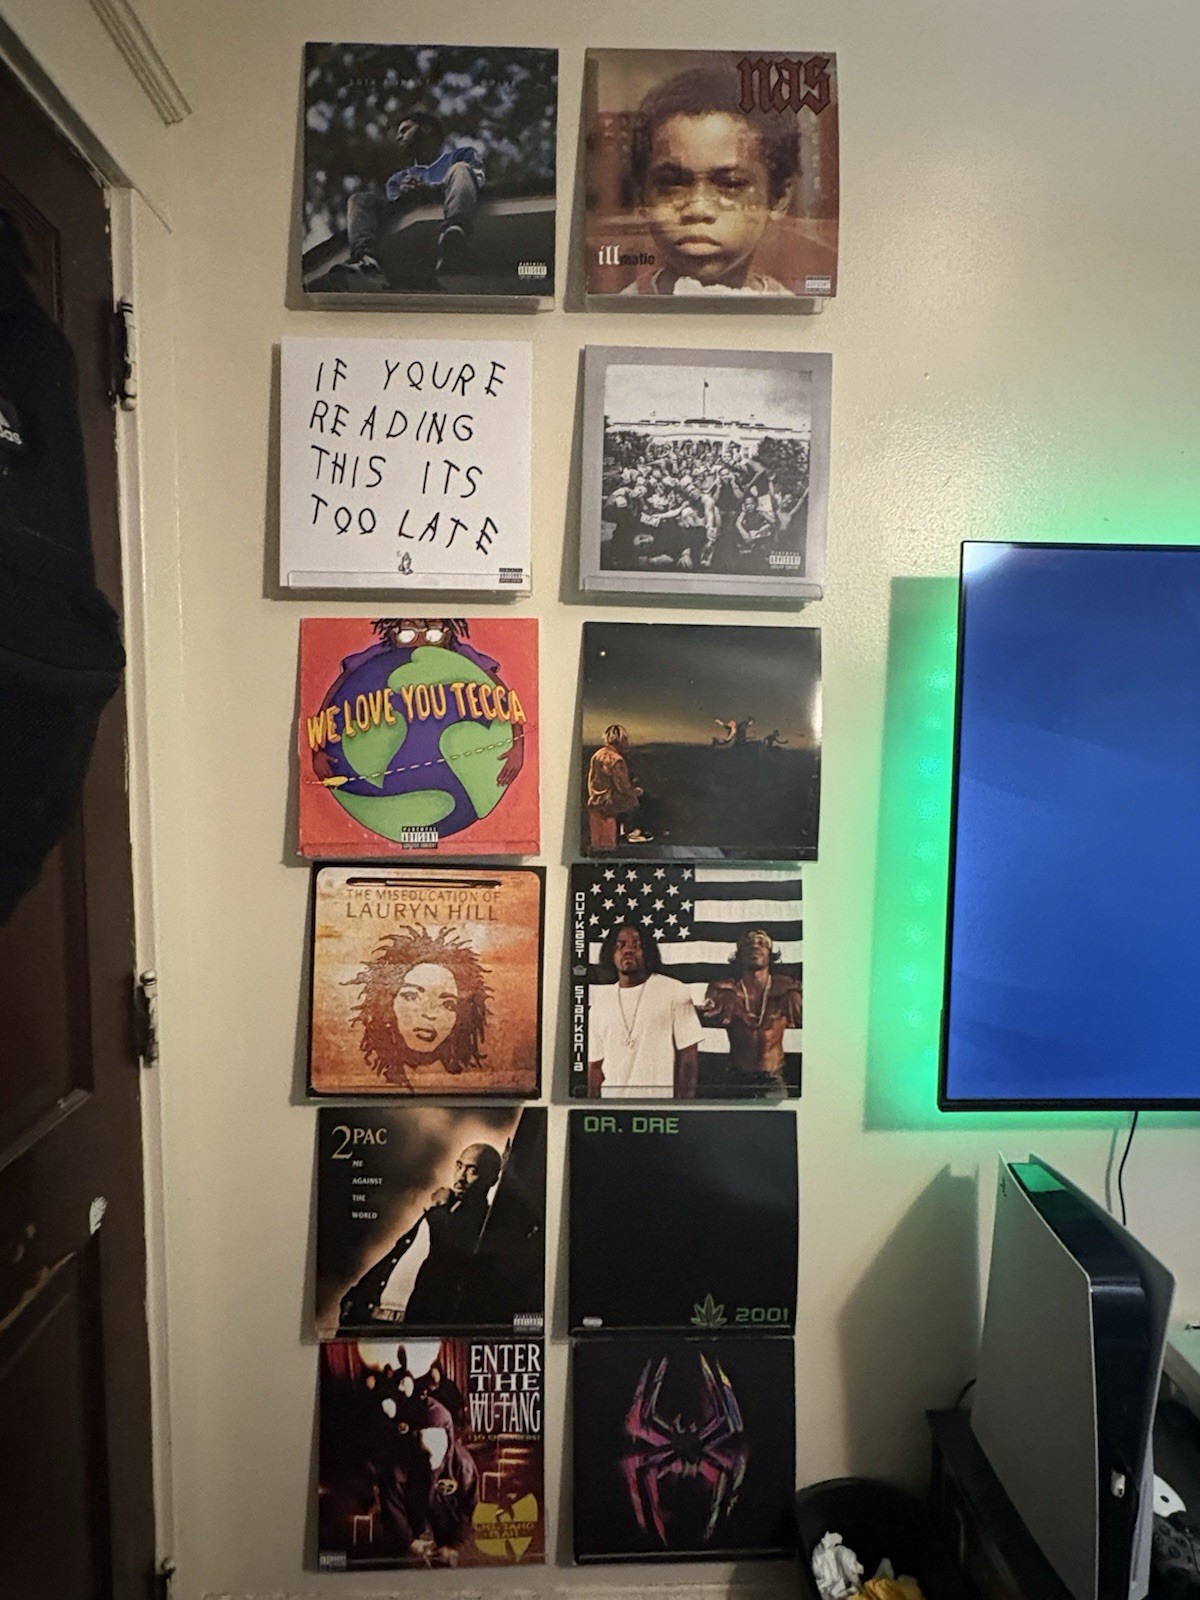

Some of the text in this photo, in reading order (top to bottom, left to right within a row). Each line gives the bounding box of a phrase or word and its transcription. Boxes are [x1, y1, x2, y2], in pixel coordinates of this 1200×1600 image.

[315, 357, 506, 397] IF YOURE
[309, 399, 474, 445] READING
[310, 444, 483, 499] THIS ITS
[311, 493, 499, 556] TOO LATE
[307, 682, 527, 751] WE LOVE YOU TECCA
[346, 888, 502, 904] THE MISEDUCATION OF
[346, 901, 499, 922] LAURYN HILL
[583, 1115, 680, 1134] DR. DRE
[331, 1125, 388, 1160] 2PAC
[352, 1160, 363, 1168] ME
[352, 1177, 383, 1185] AGAINST
[352, 1194, 366, 1202] THE
[351, 1211, 378, 1220] WORLD
[735, 1307, 789, 1323] 2001
[470, 1344, 542, 1373] ENTER
[470, 1373, 540, 1391] THE
[469, 1392, 541, 1433] WU-TANG
